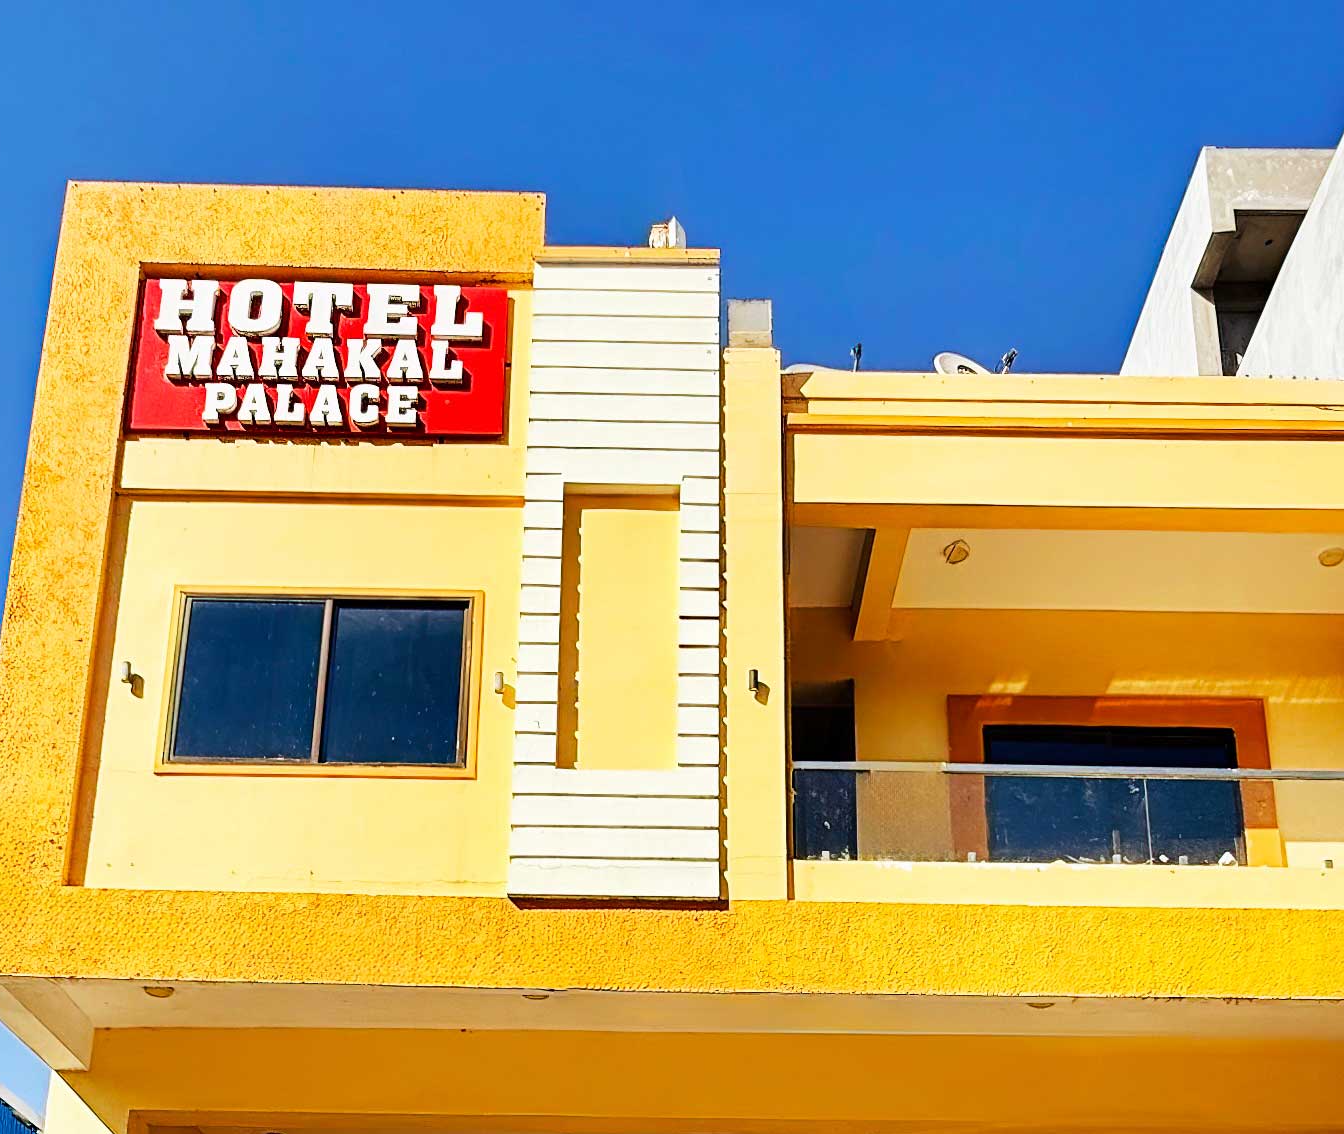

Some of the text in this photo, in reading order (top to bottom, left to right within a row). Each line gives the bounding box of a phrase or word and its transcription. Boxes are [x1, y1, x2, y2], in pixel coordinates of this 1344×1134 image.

[154, 278, 484, 341] HOTEL
[164, 335, 464, 384] MAHAKAL
[202, 383, 419, 428] PALACE
